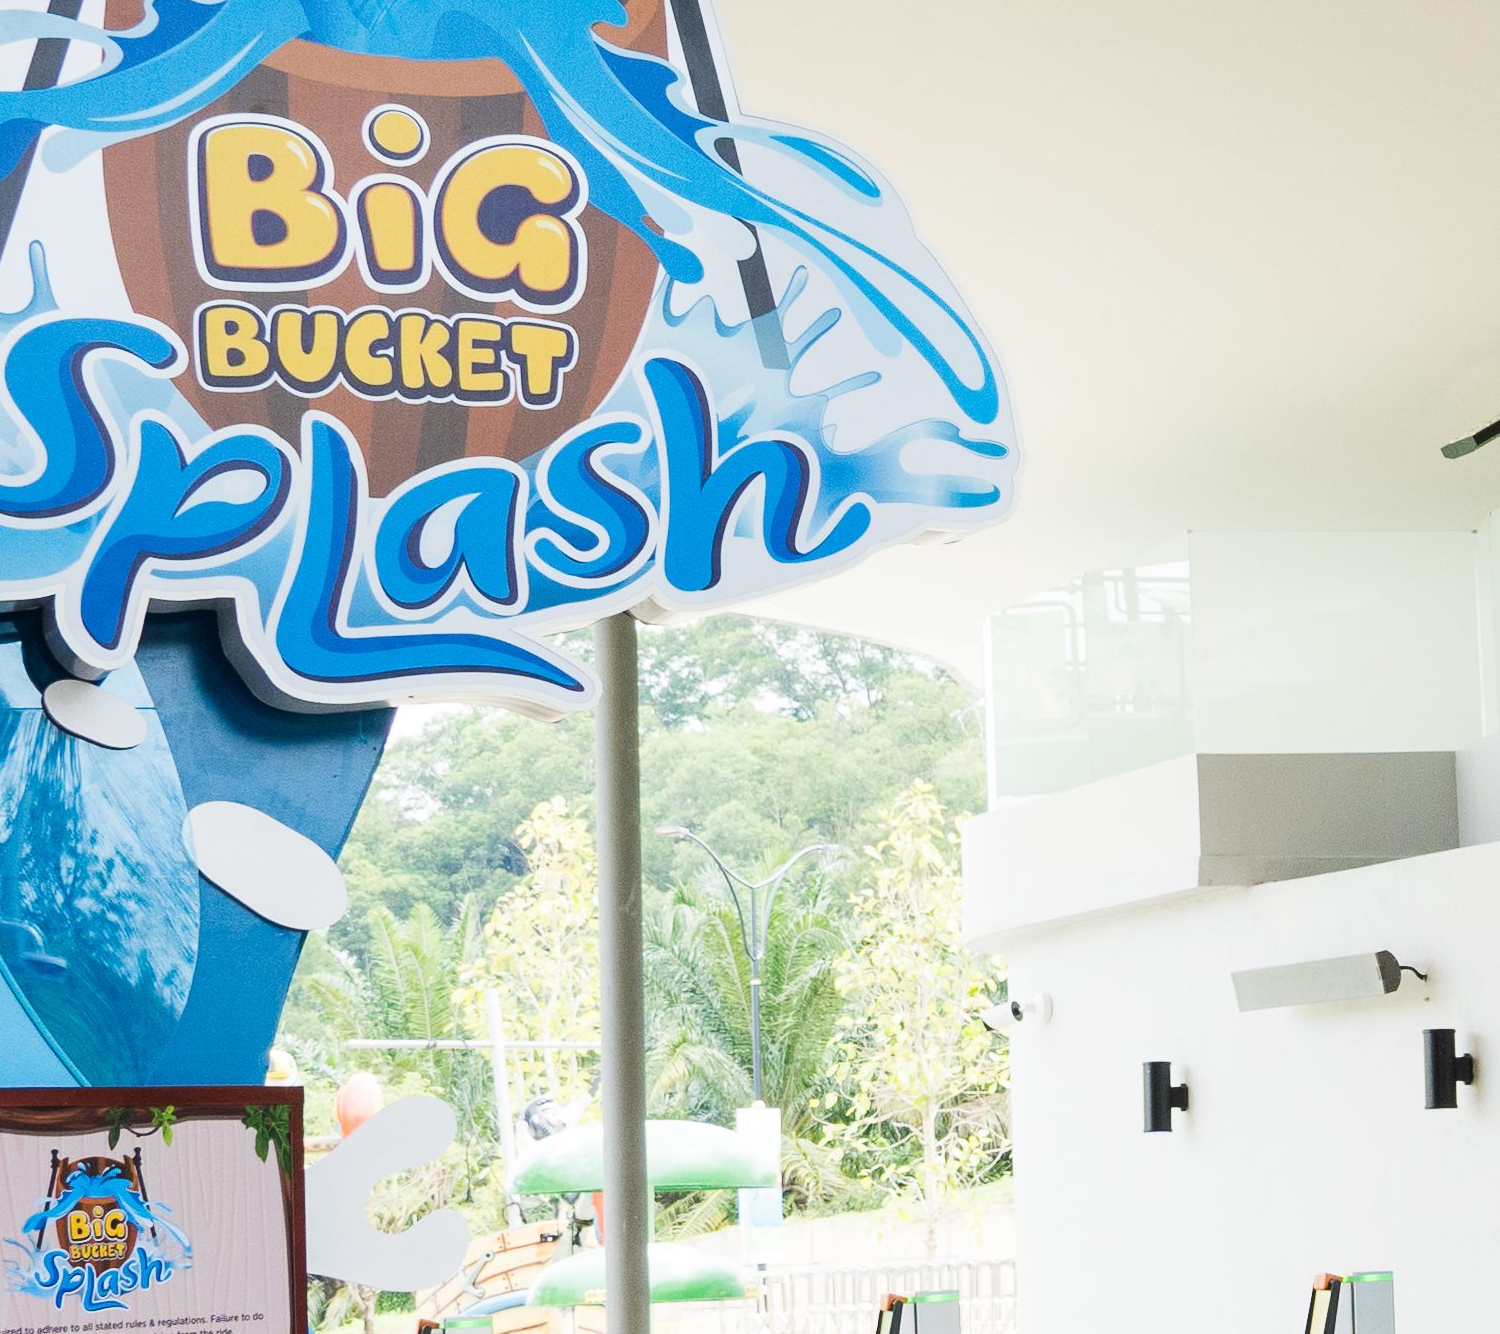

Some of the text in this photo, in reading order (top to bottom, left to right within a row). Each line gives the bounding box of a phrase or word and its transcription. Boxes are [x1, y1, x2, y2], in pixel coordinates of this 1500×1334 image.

[195, 305, 576, 408] BUCKET
[68, 1241, 128, 1262] BUCKET
[34, 1246, 173, 1312] Splash
[24, 1326, 34, 1334] to
[36, 1324, 68, 1333] adhere
[70, 1323, 80, 1331] to
[82, 1322, 93, 1331] all
[94, 1320, 123, 1330] stated
[125, 1319, 146, 1328] rules
[148, 1318, 155, 1328] &
[157, 1315, 206, 1327] regulations.
[209, 1313, 238, 1323] Failure
[241, 1312, 250, 1321] to
[252, 1312, 263, 1320] do
